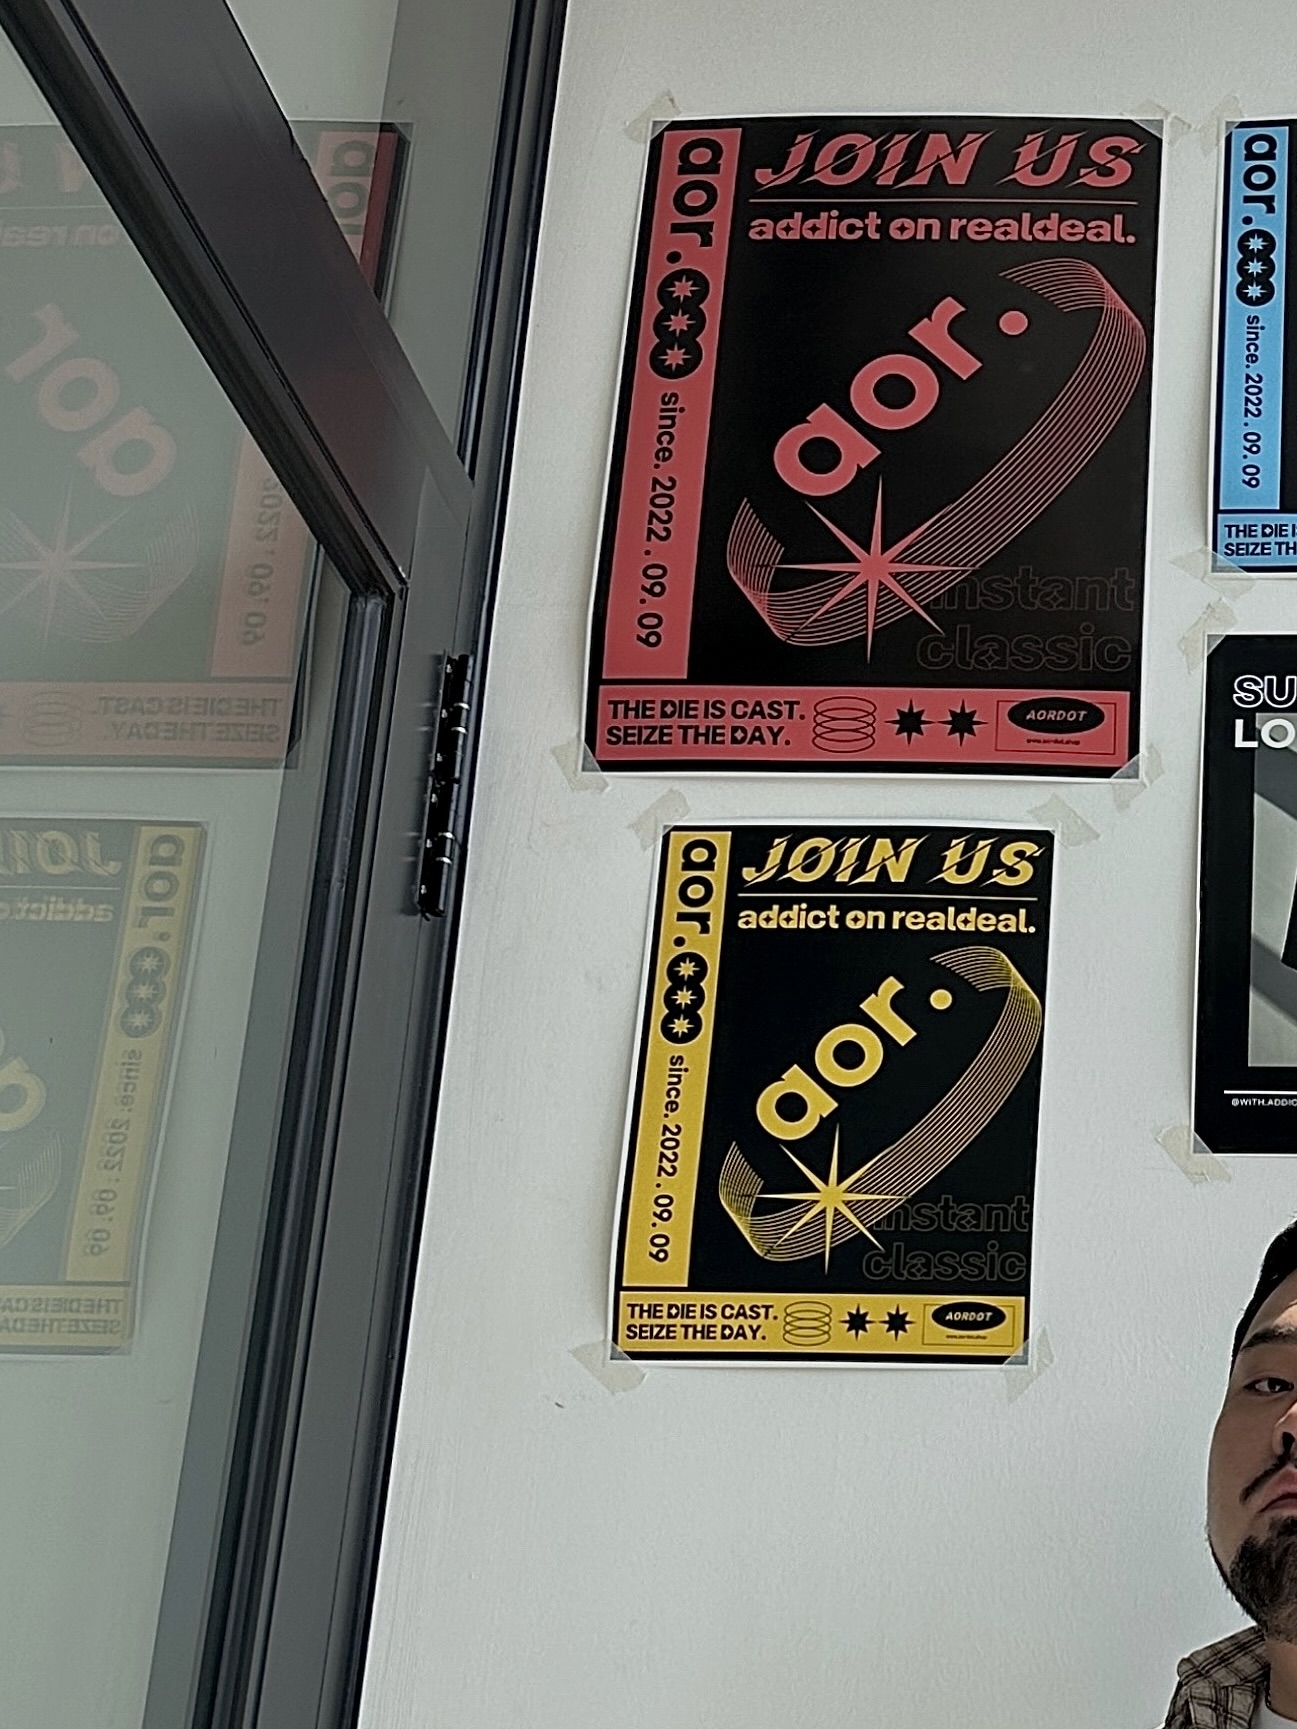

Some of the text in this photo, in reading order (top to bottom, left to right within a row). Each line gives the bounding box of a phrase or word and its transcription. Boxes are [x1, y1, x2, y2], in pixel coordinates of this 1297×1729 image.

[754, 130, 1145, 190] JOIN US
[748, 210, 1137, 244] addict on realdeal.
[1245, 314, 1266, 369] since.
[653, 391, 686, 470] since.
[1223, 523, 1258, 539] THE
[1261, 523, 1289, 538] DIE
[1223, 541, 1272, 557] SEIZE
[916, 621, 1132, 672] classic
[607, 699, 806, 720] THE DIE IS CAST.
[605, 724, 791, 746] SEIZE THE DAY.
[742, 835, 1044, 887] JOIN US
[737, 902, 1036, 934] addict on realdeal.
[663, 1054, 689, 1118] since.
[862, 1240, 1027, 1282] classic
[626, 1303, 778, 1320] THE DIE IS CAST.
[625, 1323, 766, 1340] SEIZE THE DAY.
